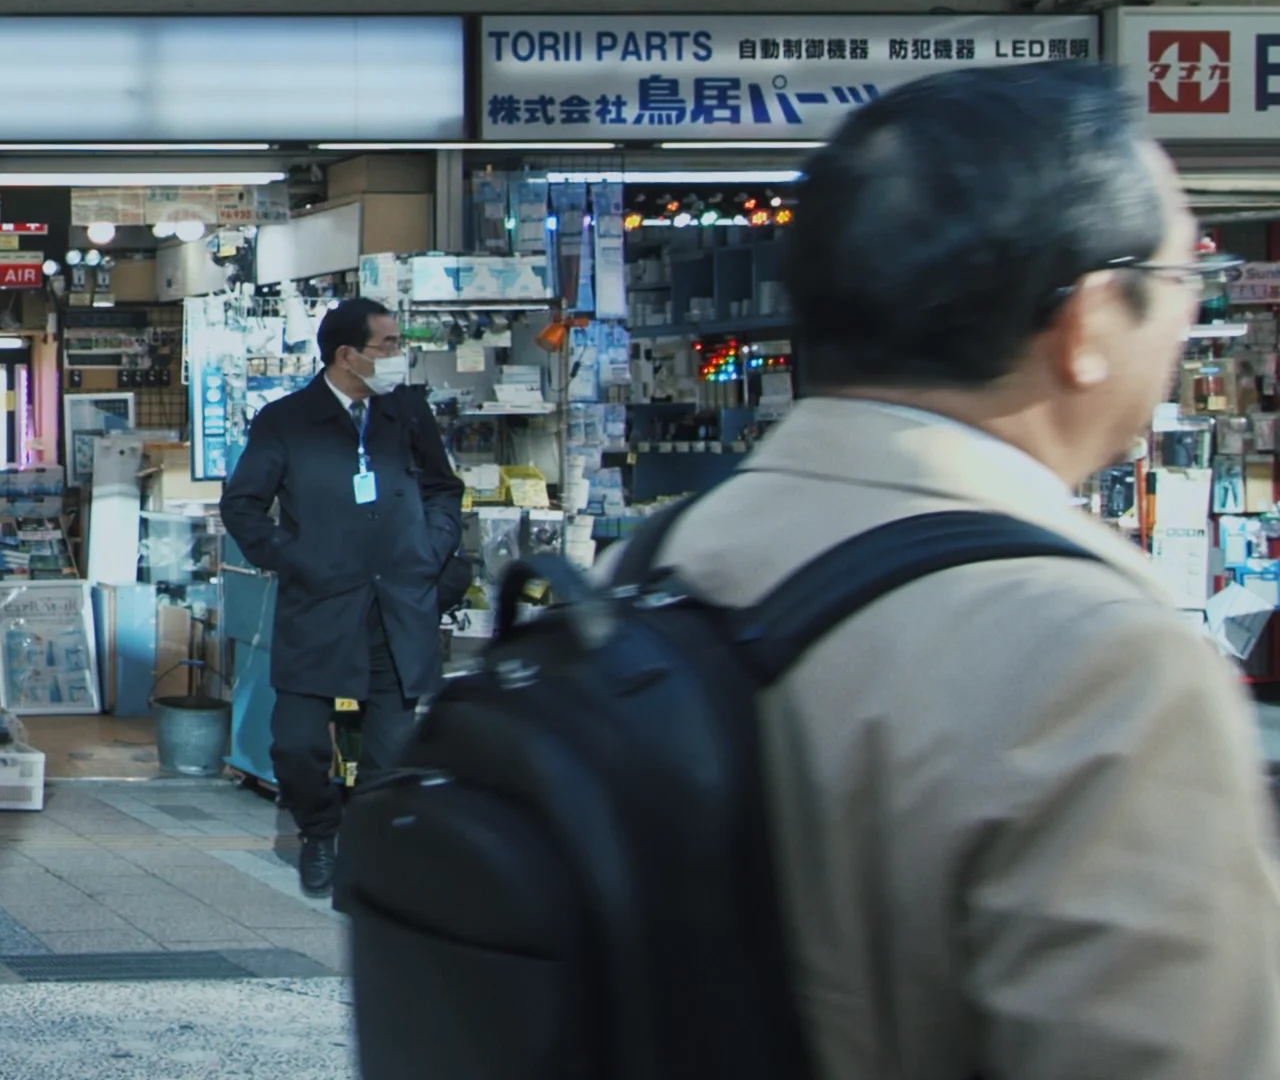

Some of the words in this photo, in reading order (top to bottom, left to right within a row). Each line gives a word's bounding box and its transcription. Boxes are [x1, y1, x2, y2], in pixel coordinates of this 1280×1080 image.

[489, 31, 582, 62] TORII
[595, 31, 713, 62] PARTS
[738, 38, 870, 60] 自動制御機器
[888, 38, 976, 60] 防犯機器
[995, 38, 1089, 60] LED照明
[1148, 64, 1229, 82] タナカ
[488, 95, 628, 126] 株式会社
[4, 269, 37, 283] AIR
